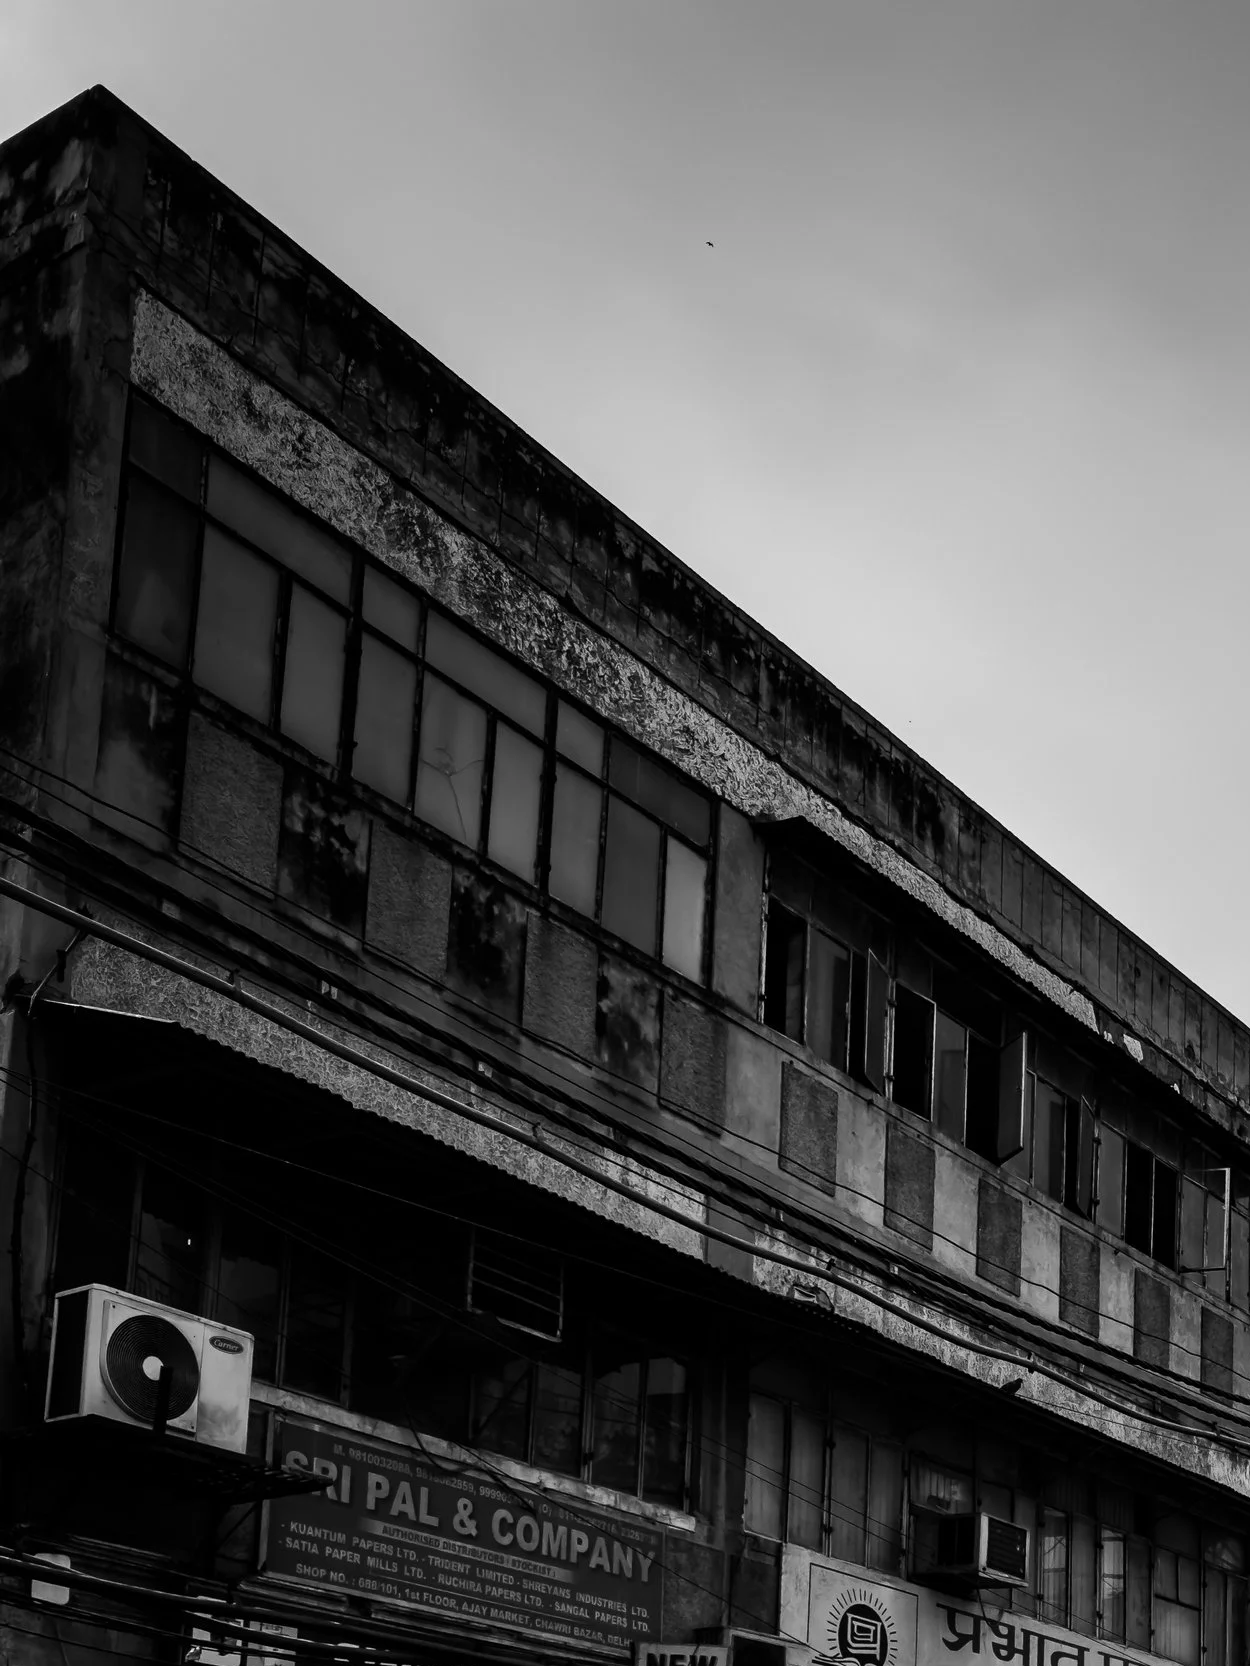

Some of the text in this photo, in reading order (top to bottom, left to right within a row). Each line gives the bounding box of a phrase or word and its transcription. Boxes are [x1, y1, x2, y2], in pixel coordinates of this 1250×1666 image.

[290, 1521, 650, 1619] KUANTUM PAPERS LTD. TRIDENT LIMITED SHREYANS INDUSTRIES LTD.
[366, 1472, 440, 1527] PAL
[452, 1497, 478, 1537] &
[491, 1508, 656, 1583] COMPANY
[285, 1537, 651, 1633] SATIA PAPER MILLS LTD. RUCHIRA PAPERS LTD. SANGAL PAPERS LTD.
[296, 1563, 327, 1579] SHOP
[423, 1592, 458, 1611] FLOOR,
[461, 1601, 488, 1618] AJAY
[490, 1607, 534, 1627] MARKET,
[535, 1617, 572, 1636] CHAWRI
[574, 1626, 606, 1644] BAZAR,
